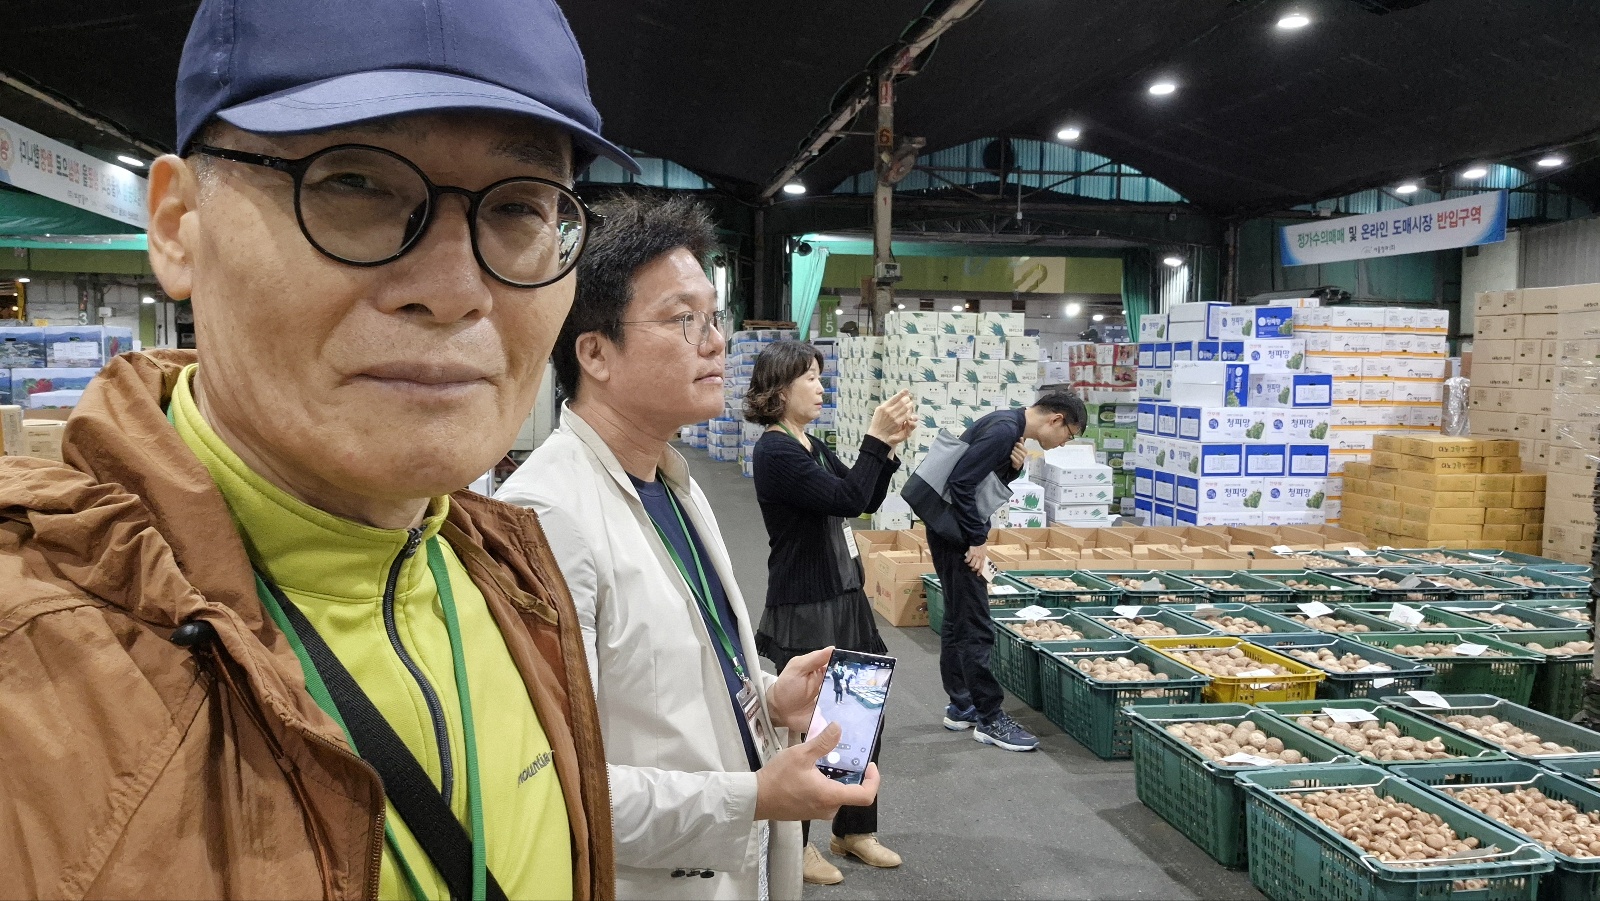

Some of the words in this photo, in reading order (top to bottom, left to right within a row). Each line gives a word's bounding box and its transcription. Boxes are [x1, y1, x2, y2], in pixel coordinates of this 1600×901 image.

[1297, 227, 1345, 249] 정가수의매매
[1348, 226, 1357, 242] 및
[1361, 221, 1389, 241] 온라인
[1391, 213, 1433, 236] 도매시장
[1436, 205, 1482, 230] 반입구역
[79, 312, 88, 325] 3
[825, 321, 834, 333] 5
[1268, 349, 1290, 359] 청피망
[1226, 418, 1250, 428] 청피망
[1291, 419, 1314, 428] 청피망
[1225, 488, 1247, 498] 청피망
[1287, 487, 1311, 498] 청피망
